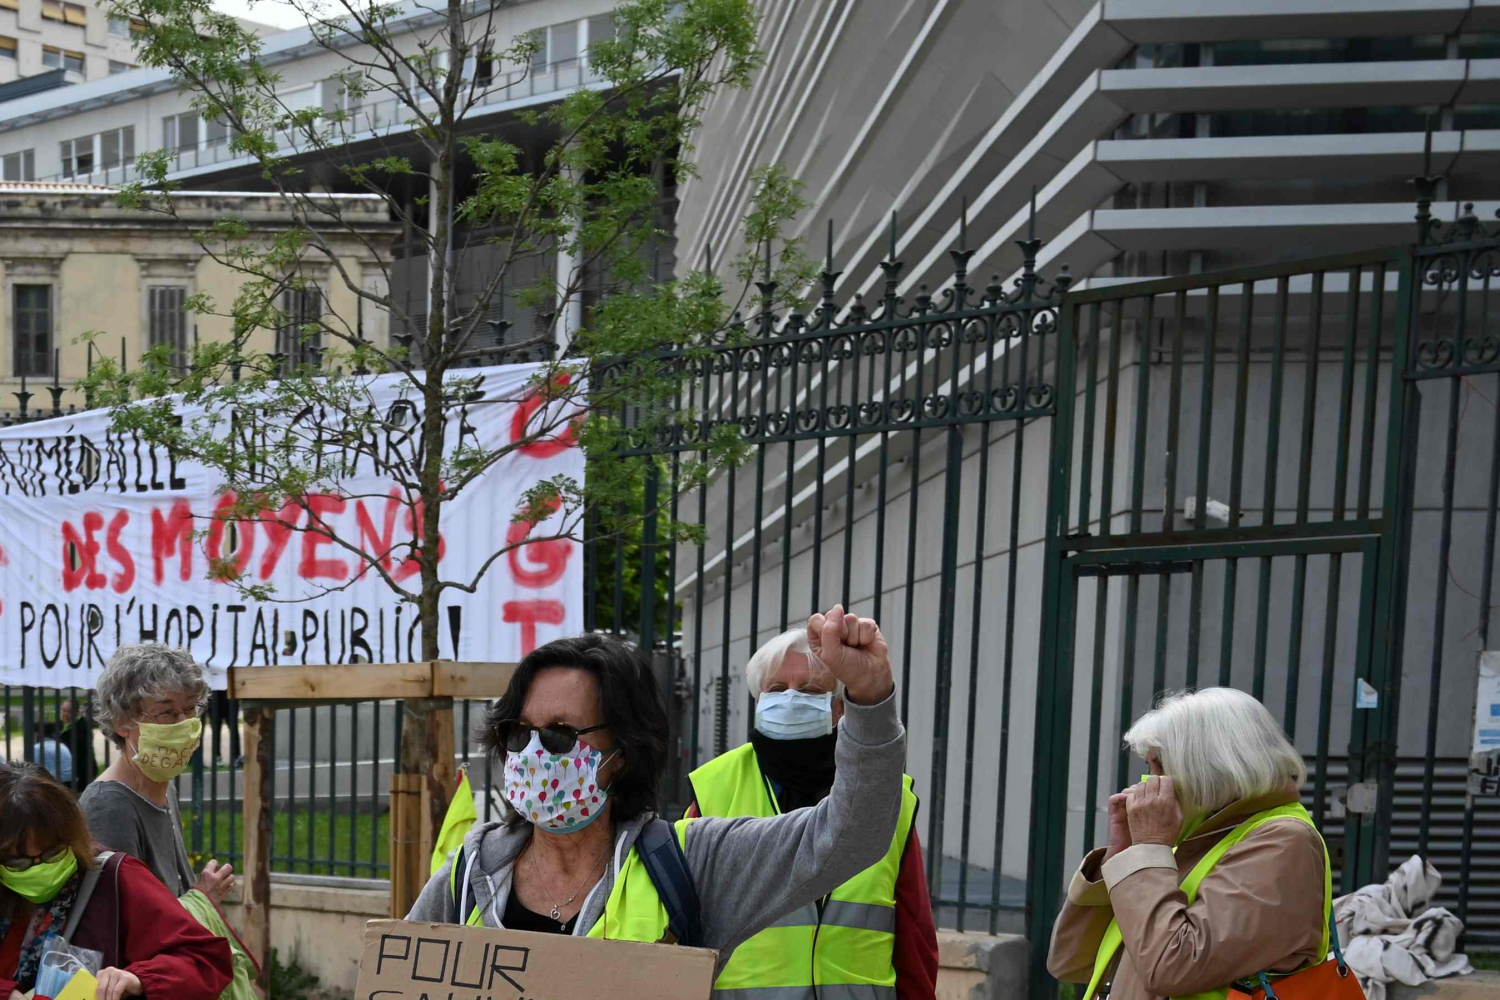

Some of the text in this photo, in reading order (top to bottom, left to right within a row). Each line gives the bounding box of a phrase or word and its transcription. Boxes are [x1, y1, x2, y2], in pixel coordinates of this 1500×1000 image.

[62, 509, 135, 593] DES
[20, 601, 106, 669] POUR
[376, 933, 530, 992] POUR
